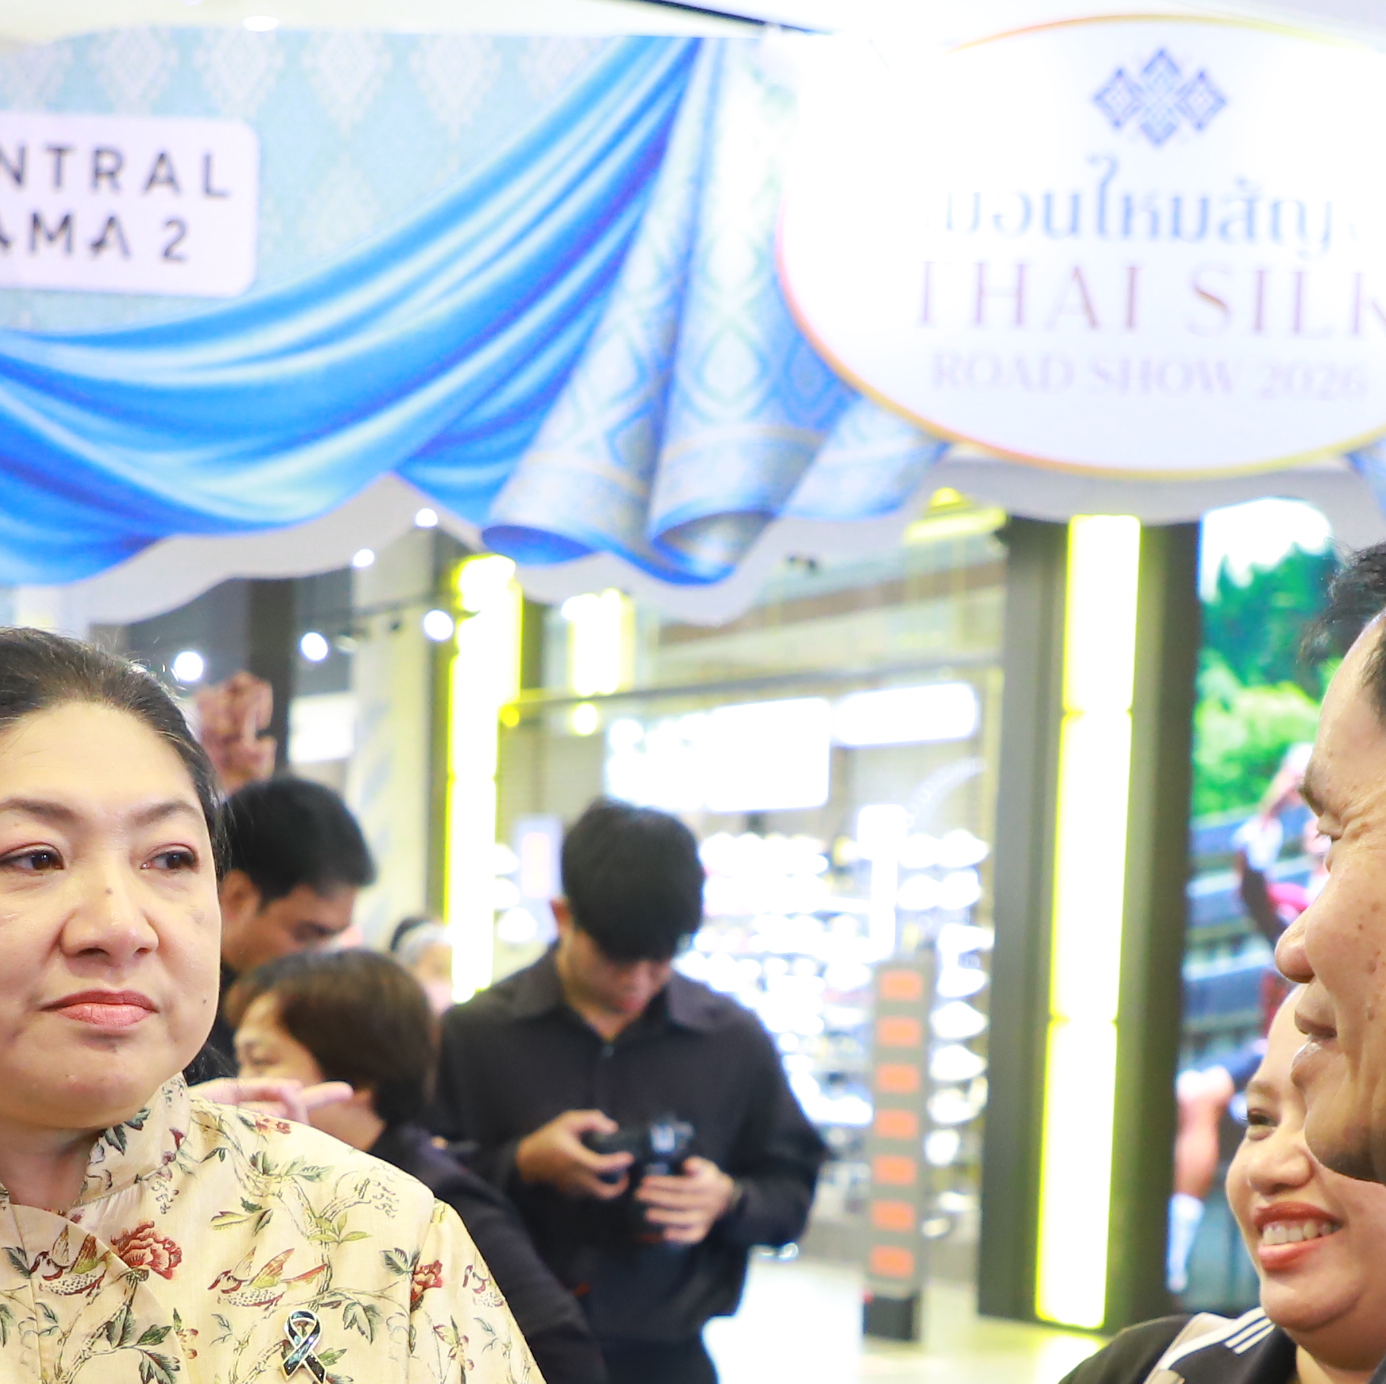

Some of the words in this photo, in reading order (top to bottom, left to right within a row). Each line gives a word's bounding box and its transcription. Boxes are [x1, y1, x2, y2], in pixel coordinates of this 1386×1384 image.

[160, 216, 189, 263] 2
[913, 256, 1143, 334] THAI
[929, 347, 1075, 394] ROAD
[1088, 350, 1245, 398] SHOW
[1258, 360, 1371, 404] 2026
